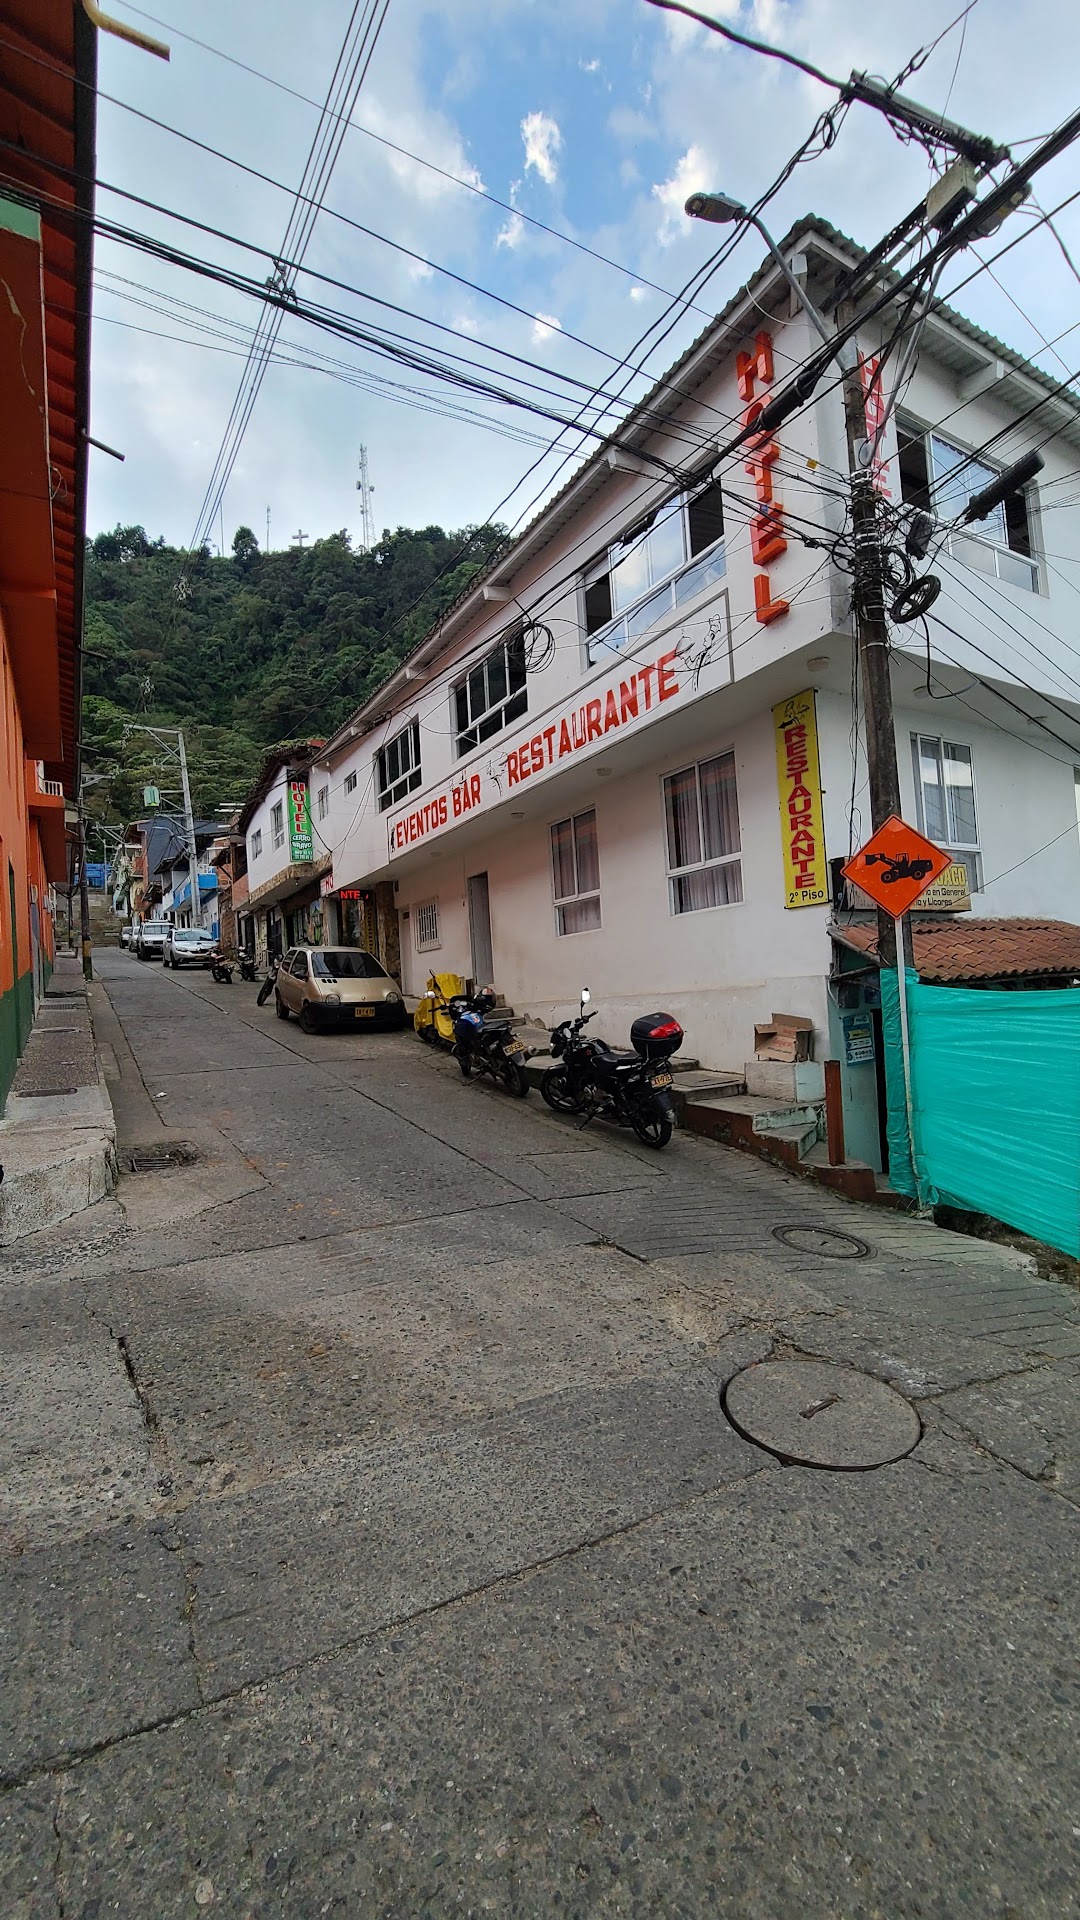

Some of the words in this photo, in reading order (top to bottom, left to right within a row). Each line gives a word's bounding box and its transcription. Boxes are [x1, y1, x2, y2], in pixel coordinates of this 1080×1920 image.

[736, 330, 790, 625] HOTEL
[396, 795, 447, 848] EVENTOS
[452, 774, 481, 818] BAR
[507, 649, 680, 788] RESTAURANTE
[290, 782, 307, 834] HOTEL
[784, 725, 817, 889] RESTAURANTE
[802, 888, 824, 901] Piso
[927, 897, 953, 906] Licores
[941, 887, 966, 896] General
